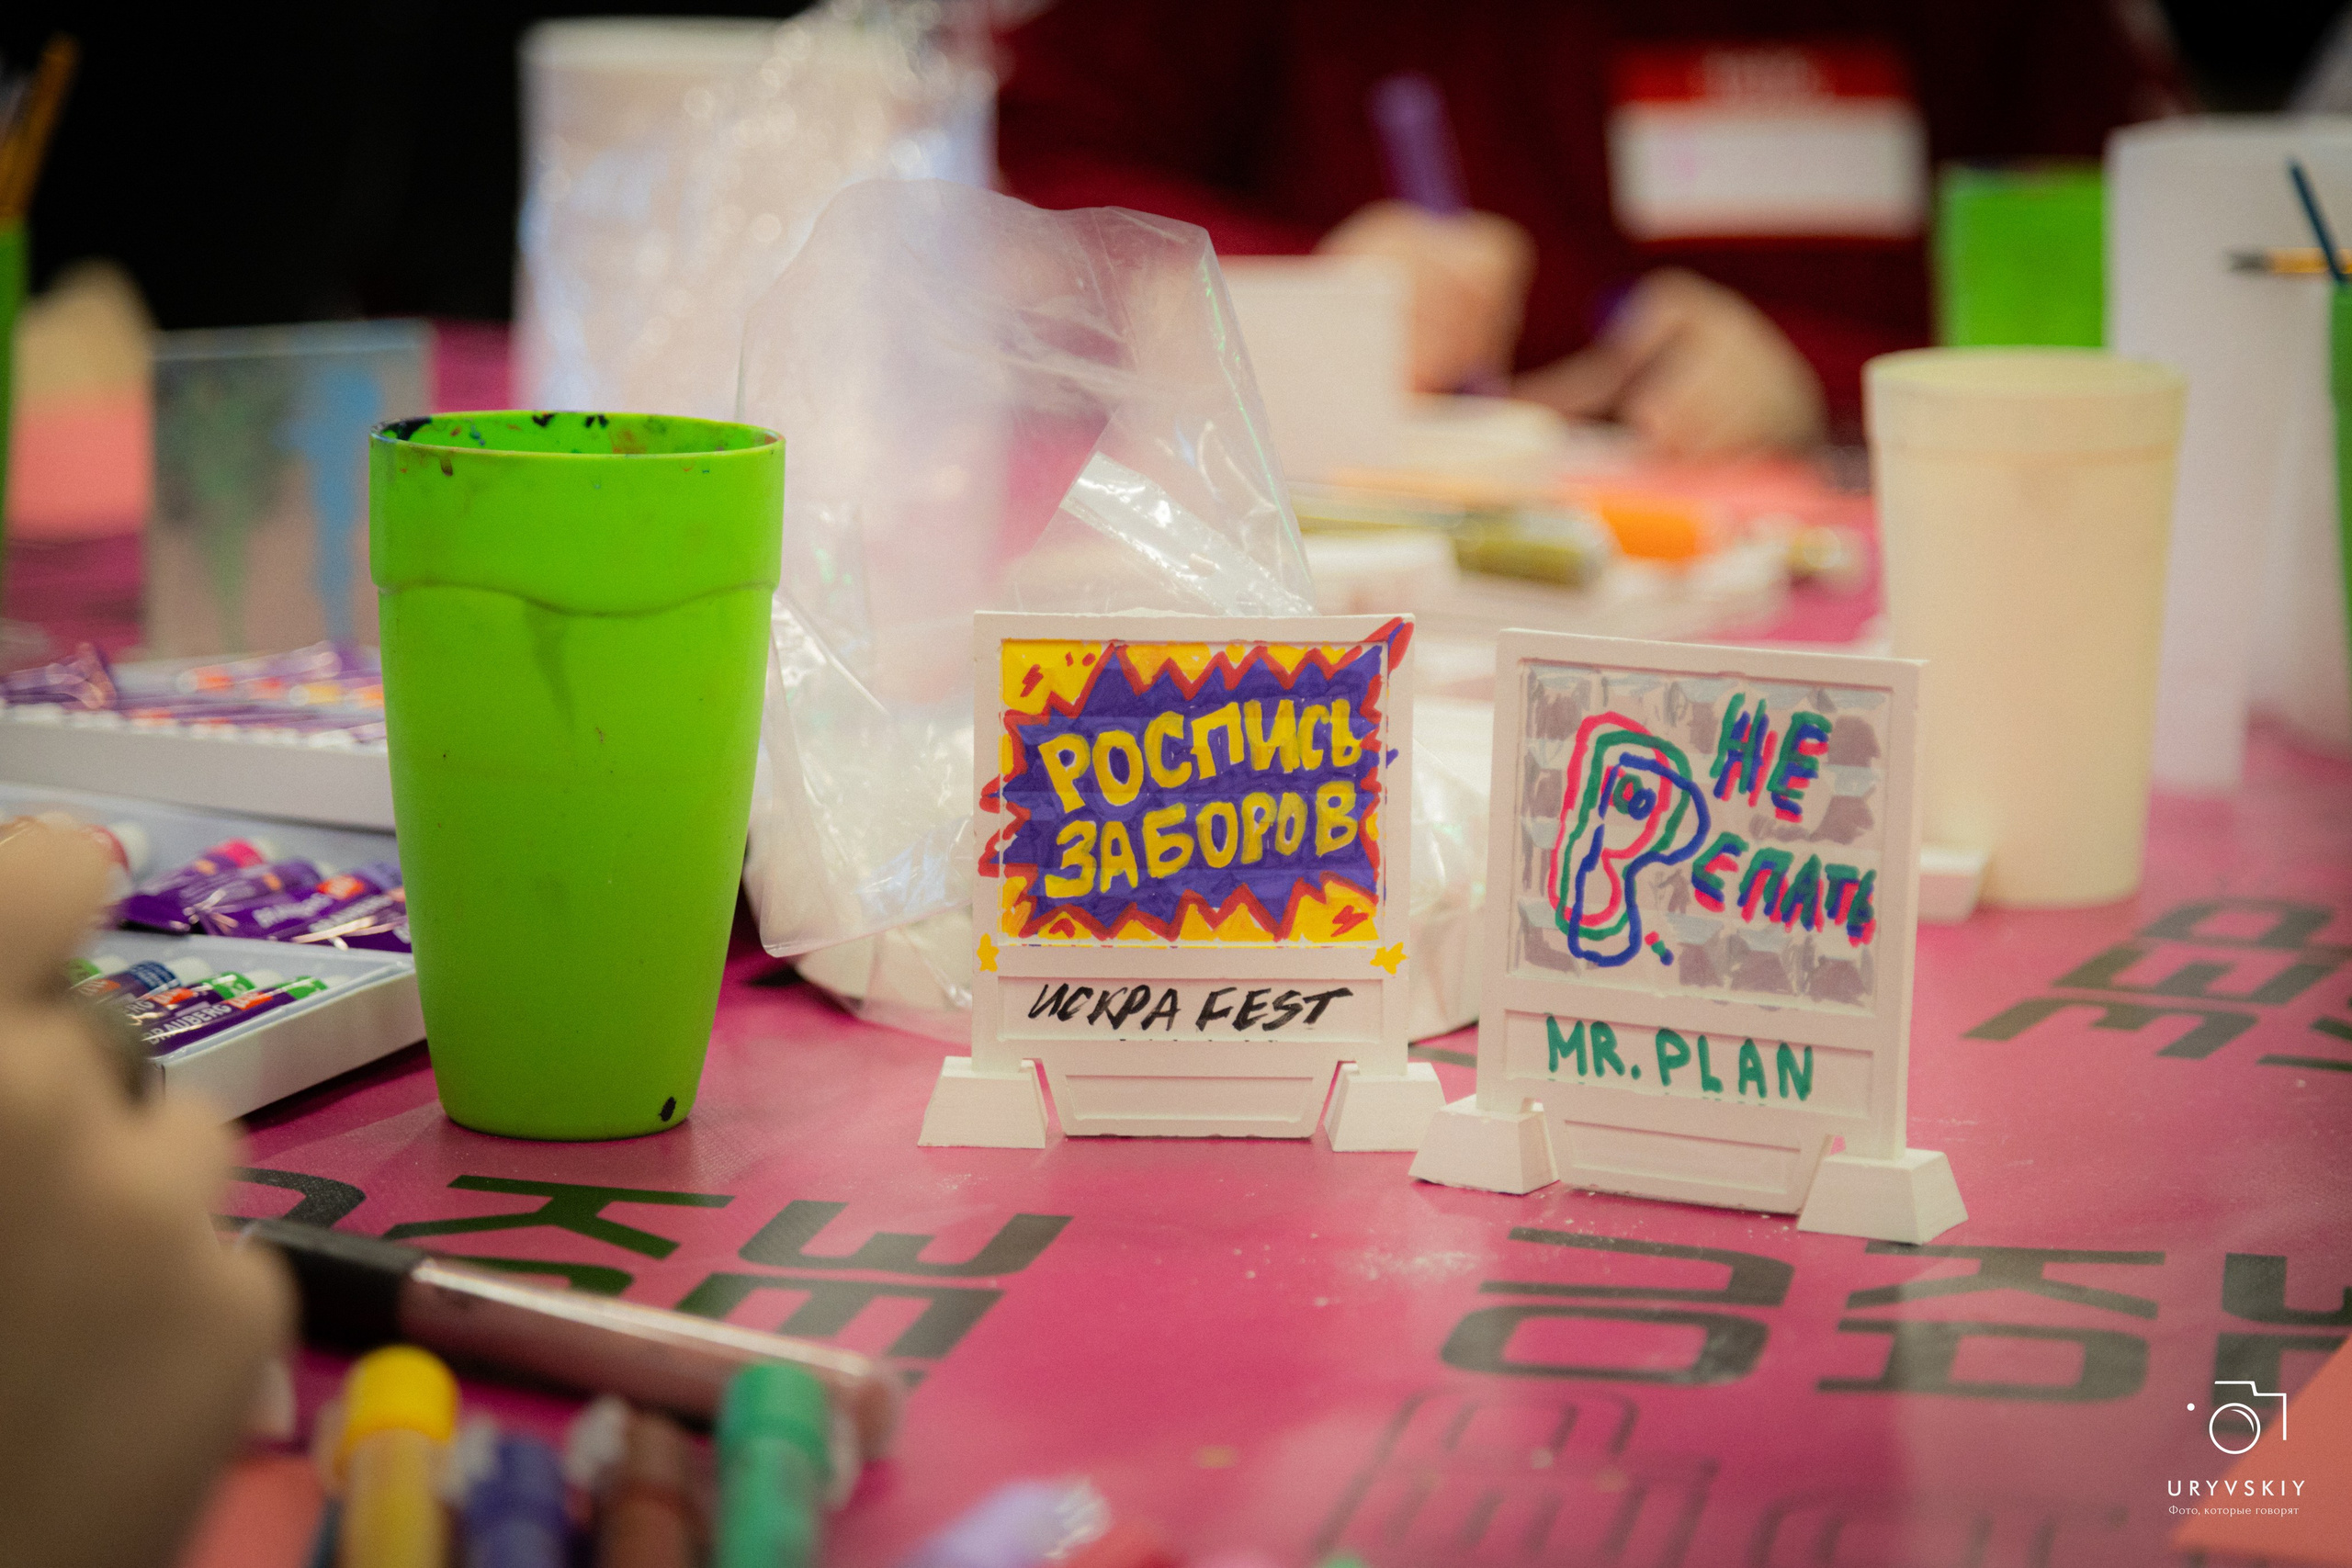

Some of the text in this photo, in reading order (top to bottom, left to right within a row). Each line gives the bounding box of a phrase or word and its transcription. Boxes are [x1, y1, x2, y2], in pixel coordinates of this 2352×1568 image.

[1037, 698, 1363, 813] РОСПИСЬ
[1709, 692, 1834, 824] НЕ
[1044, 781, 1359, 898] ЗАБОРОВ
[1690, 830, 1878, 949] СПАТЬ
[1027, 982, 1354, 1032] ИСКРА FEST
[1545, 1014, 1815, 1101] MR. PLAN
